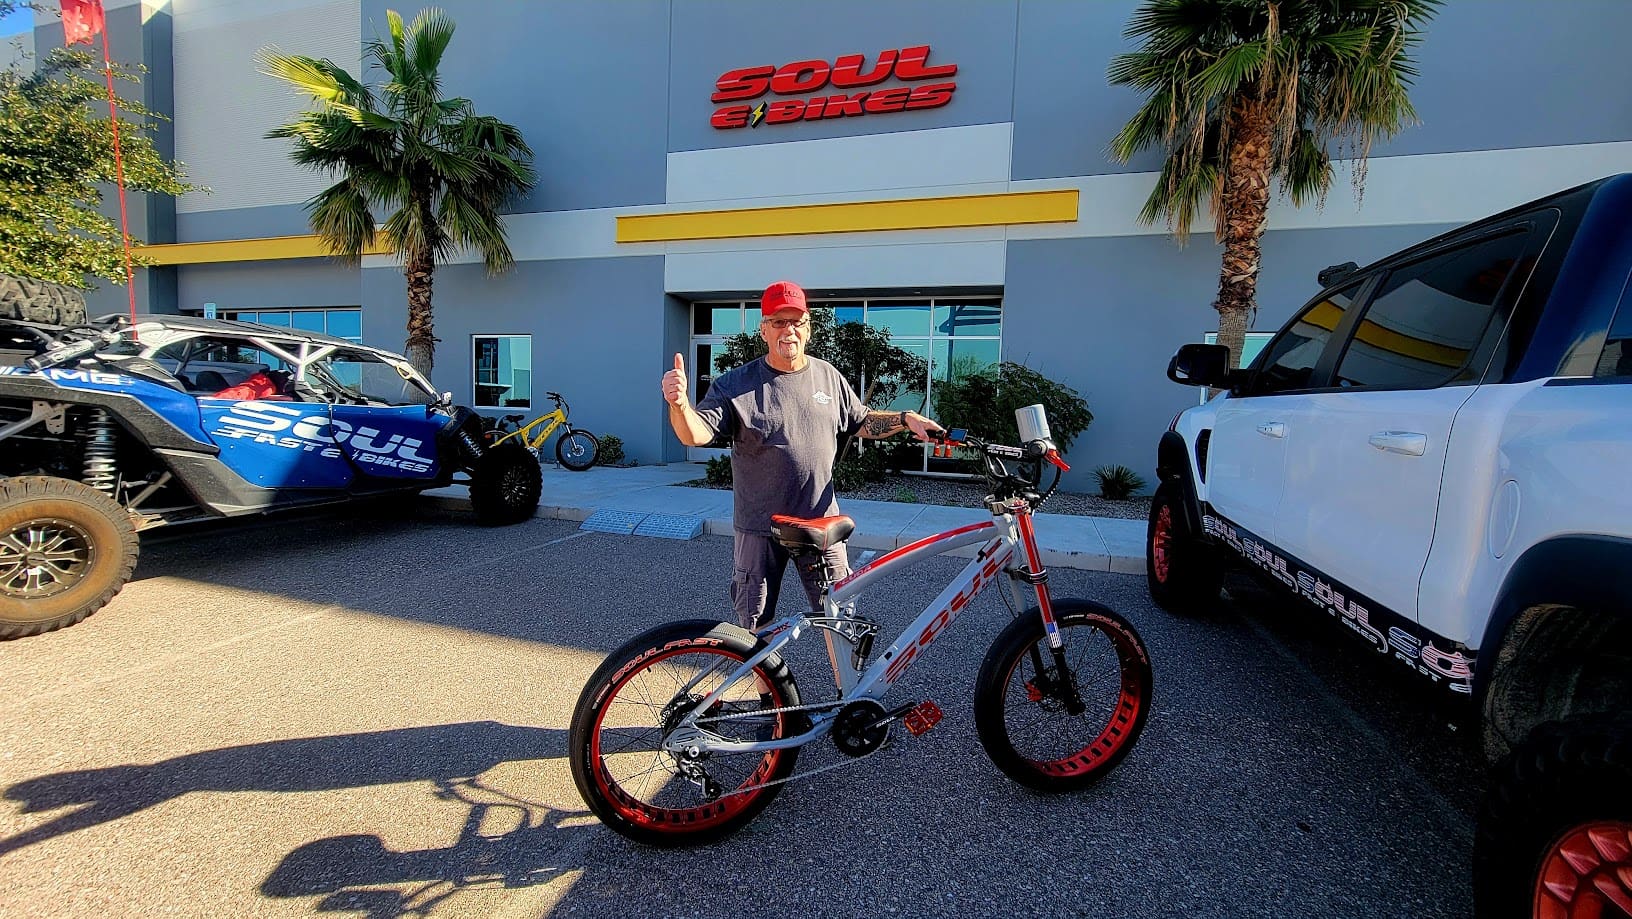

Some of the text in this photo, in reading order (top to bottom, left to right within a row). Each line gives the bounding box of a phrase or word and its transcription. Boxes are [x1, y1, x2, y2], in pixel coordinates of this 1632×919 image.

[711, 45, 957, 103] SOUL
[211, 425, 321, 451] FAST
[359, 453, 430, 473] BIKES
[219, 401, 434, 464] SOUL
[1243, 537, 1298, 593] SOUL
[886, 537, 1013, 684] SOUL
[1297, 570, 1388, 654] SOUL
[611, 637, 724, 685] SOUL FAST
